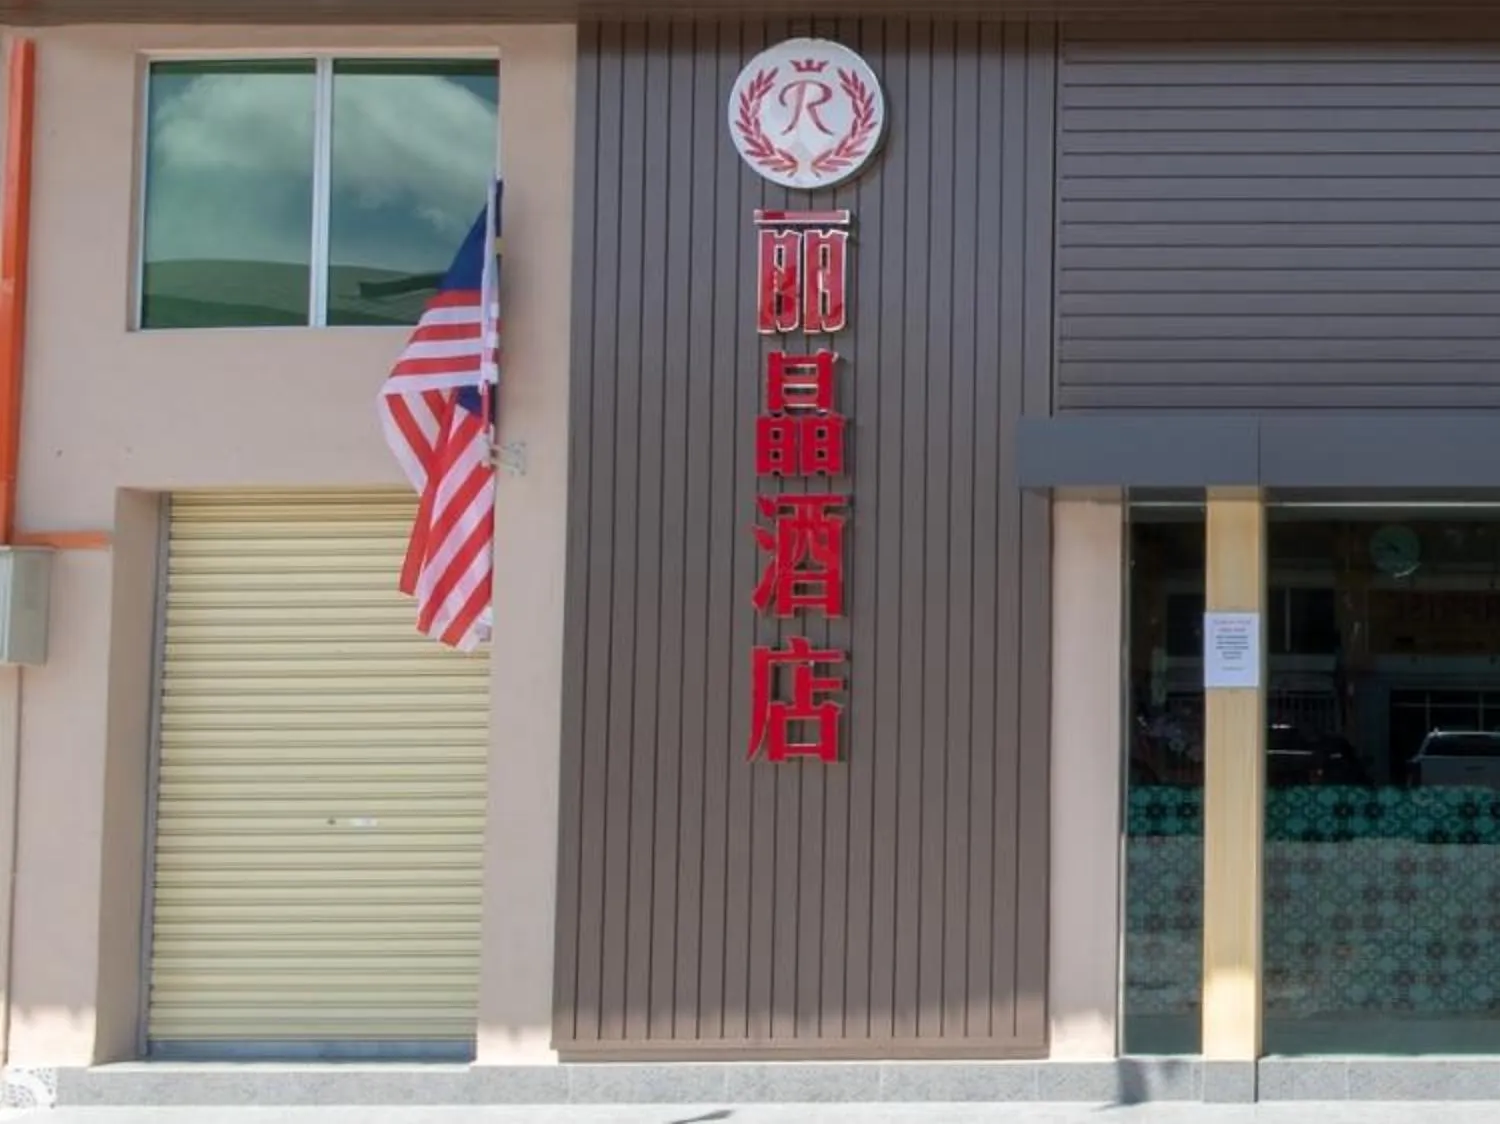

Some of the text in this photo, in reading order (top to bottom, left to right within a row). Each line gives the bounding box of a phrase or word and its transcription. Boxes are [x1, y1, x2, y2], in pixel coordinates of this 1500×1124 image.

[778, 79, 834, 136] R
[746, 209, 850, 763] 丽晶酒店
